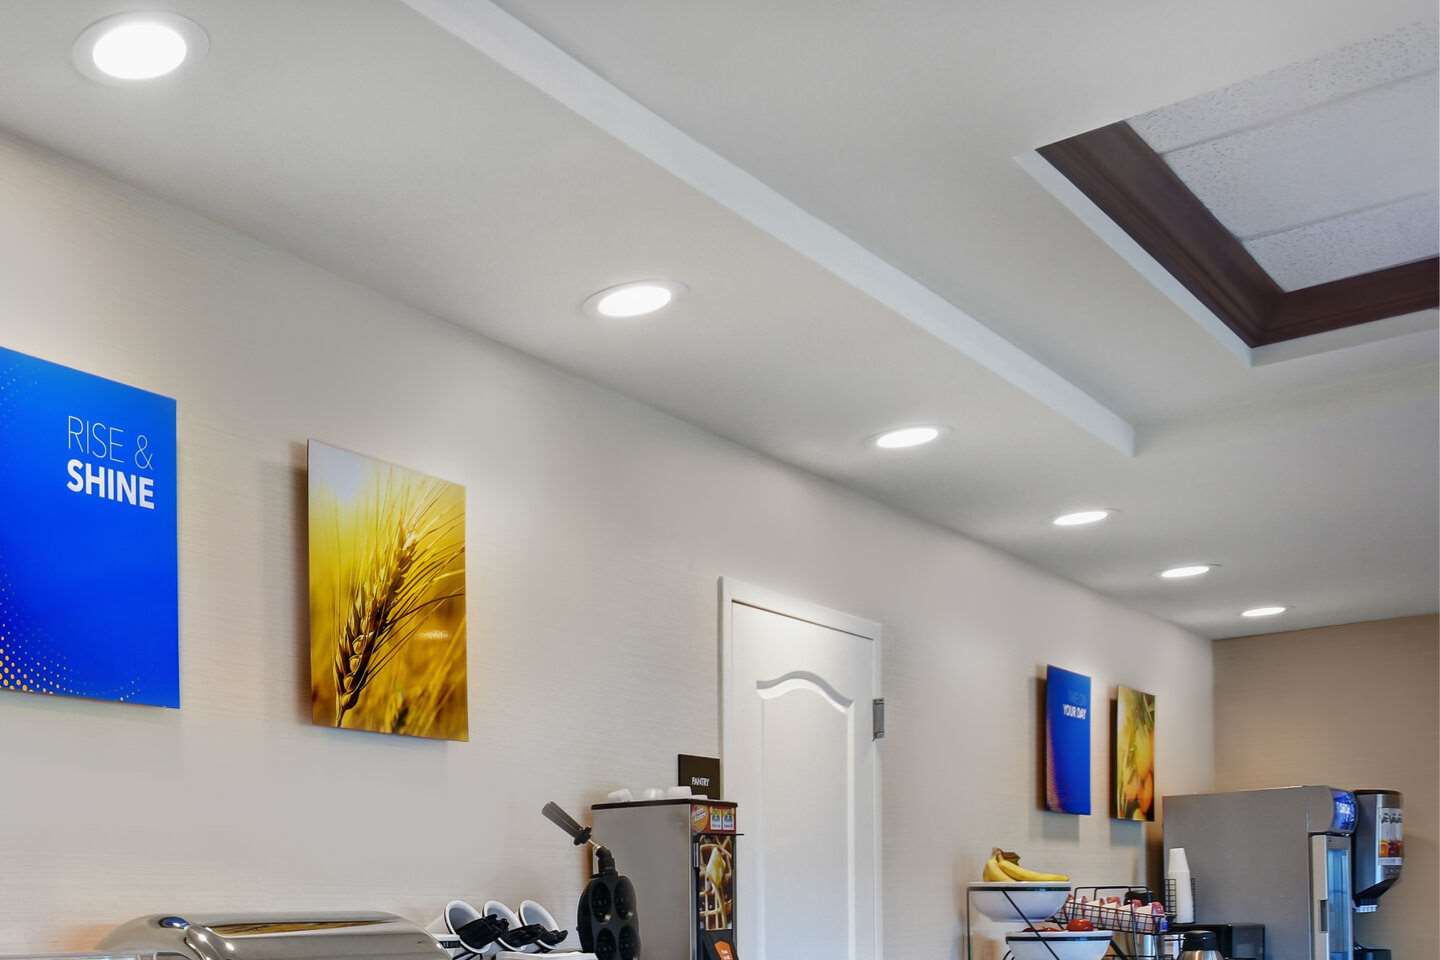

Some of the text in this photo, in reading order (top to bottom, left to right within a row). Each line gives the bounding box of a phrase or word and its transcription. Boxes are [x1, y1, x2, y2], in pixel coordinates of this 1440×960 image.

[67, 415, 153, 471] RISE &
[66, 458, 155, 510] SHINE
[691, 776, 710, 787] PANTRY
